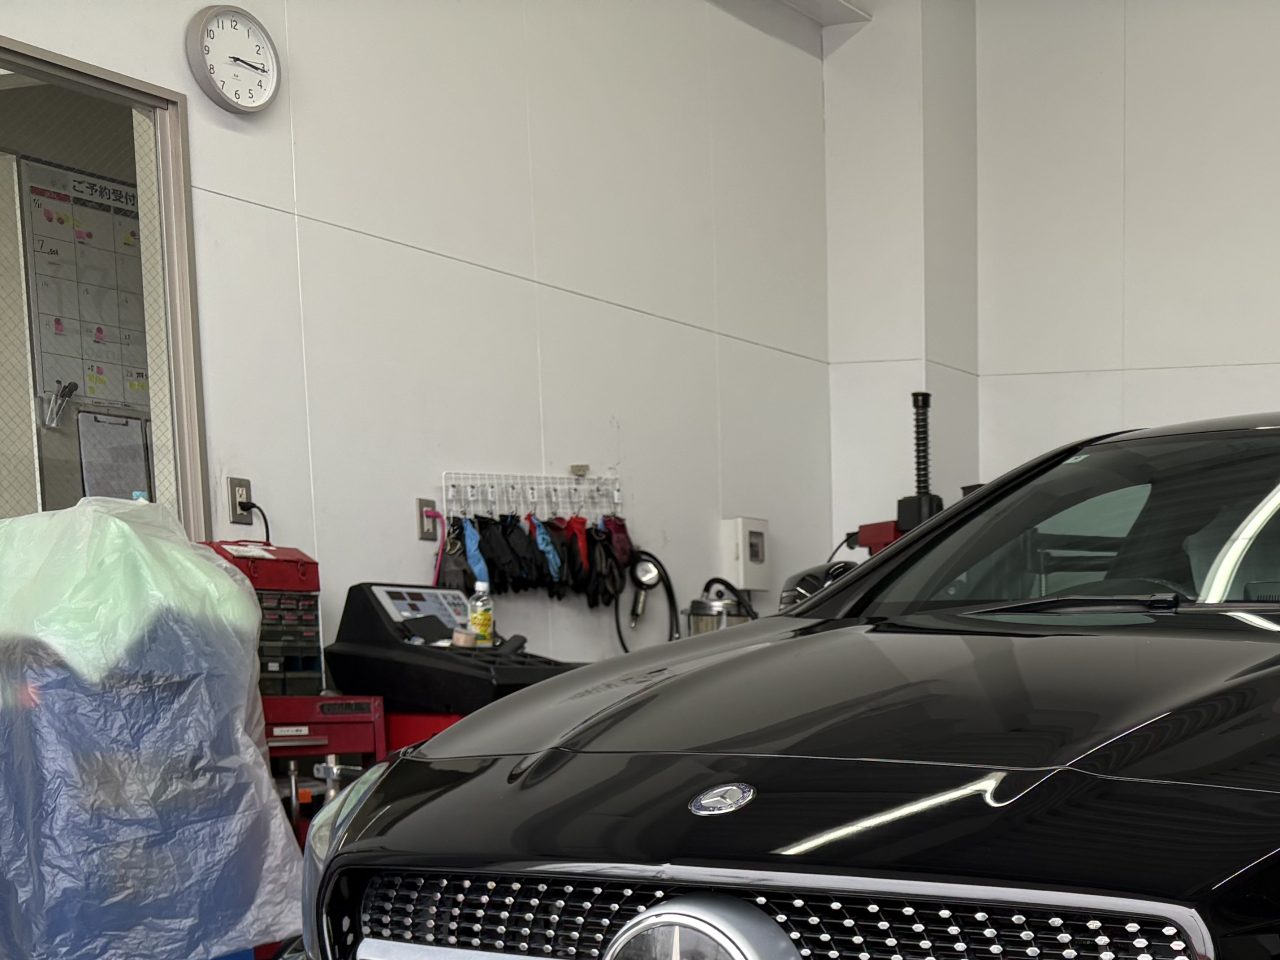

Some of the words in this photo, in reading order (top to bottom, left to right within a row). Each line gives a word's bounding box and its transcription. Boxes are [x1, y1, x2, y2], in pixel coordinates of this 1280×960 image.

[217, 18, 224, 30] 11
[230, 18, 238, 30] 12
[206, 28, 215, 40] 10
[204, 45, 210, 55] 9
[255, 44, 261, 55] 2
[209, 64, 215, 75] 8
[220, 80, 226, 90] 7
[257, 79, 263, 89] 4
[234, 89, 240, 100] 6
[248, 89, 254, 99] 5
